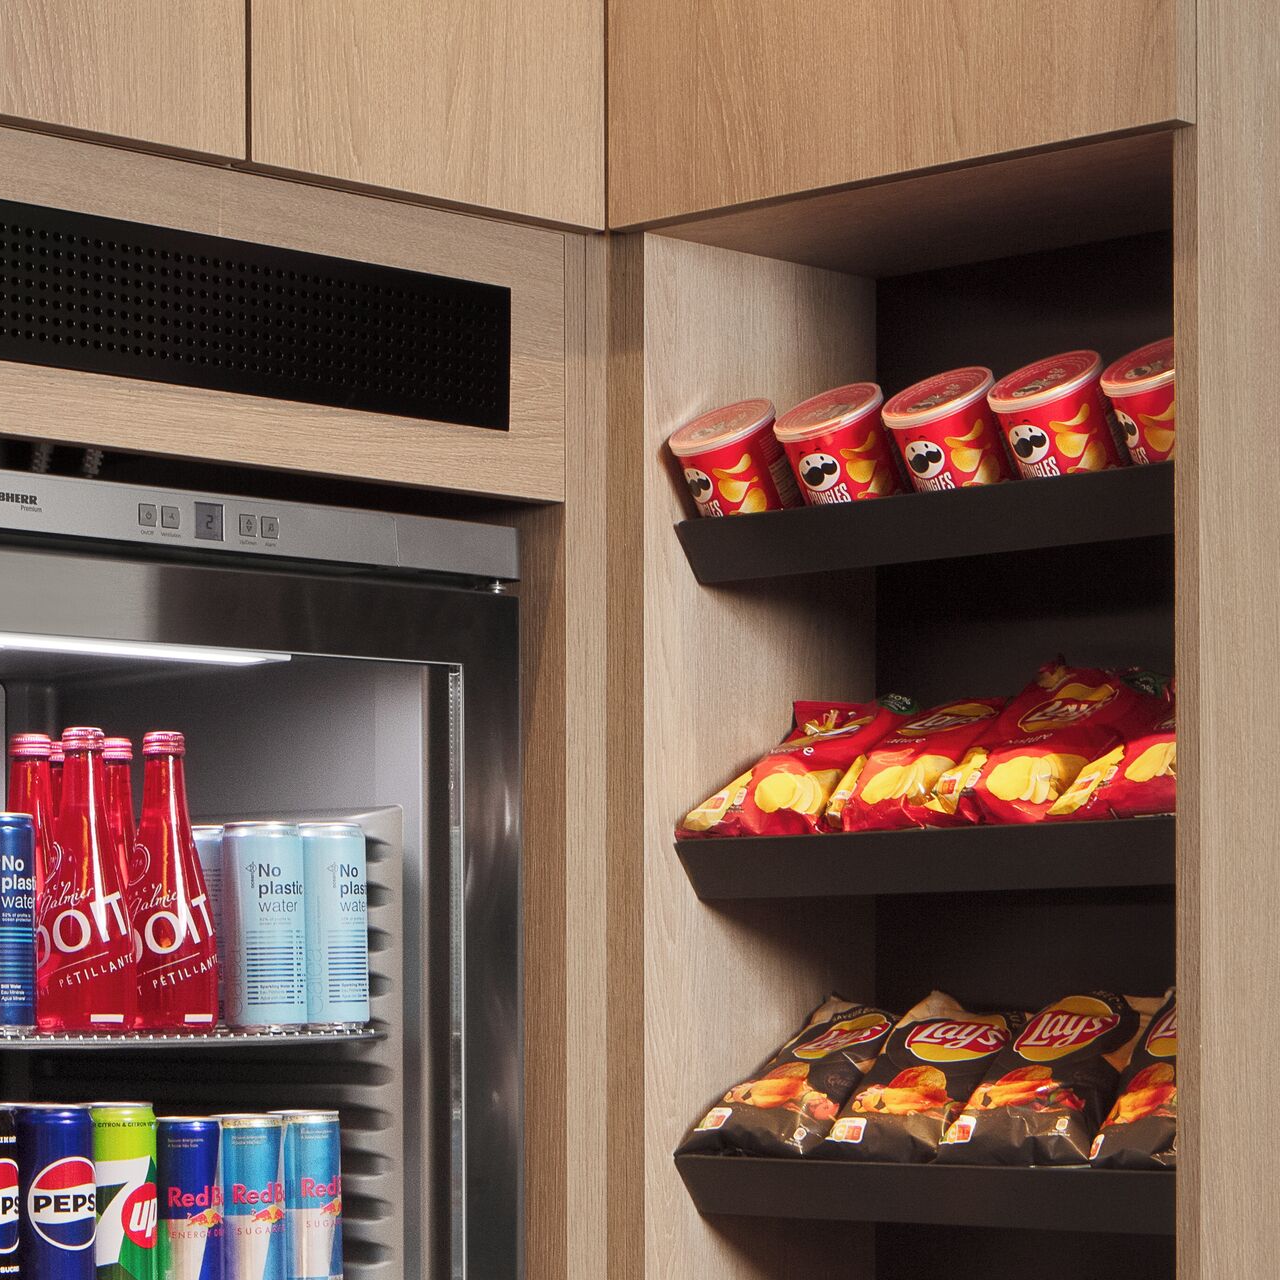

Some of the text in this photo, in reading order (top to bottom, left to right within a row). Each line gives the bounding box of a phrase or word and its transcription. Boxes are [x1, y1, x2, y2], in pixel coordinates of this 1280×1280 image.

[205, 514, 214, 530] 2
[1, 855, 24, 871] No
[259, 864, 281, 877] No
[340, 864, 358, 878] No
[259, 900, 298, 912] water
[59, 952, 133, 988] PÉTILLANTE
[913, 1022, 1005, 1049] Lay's
[1021, 1013, 1112, 1048] Lay's
[167, 1185, 209, 1208] Red
[232, 1182, 275, 1205] Red
[300, 1176, 338, 1198] Red
[172, 1228, 212, 1239] ENERGY
